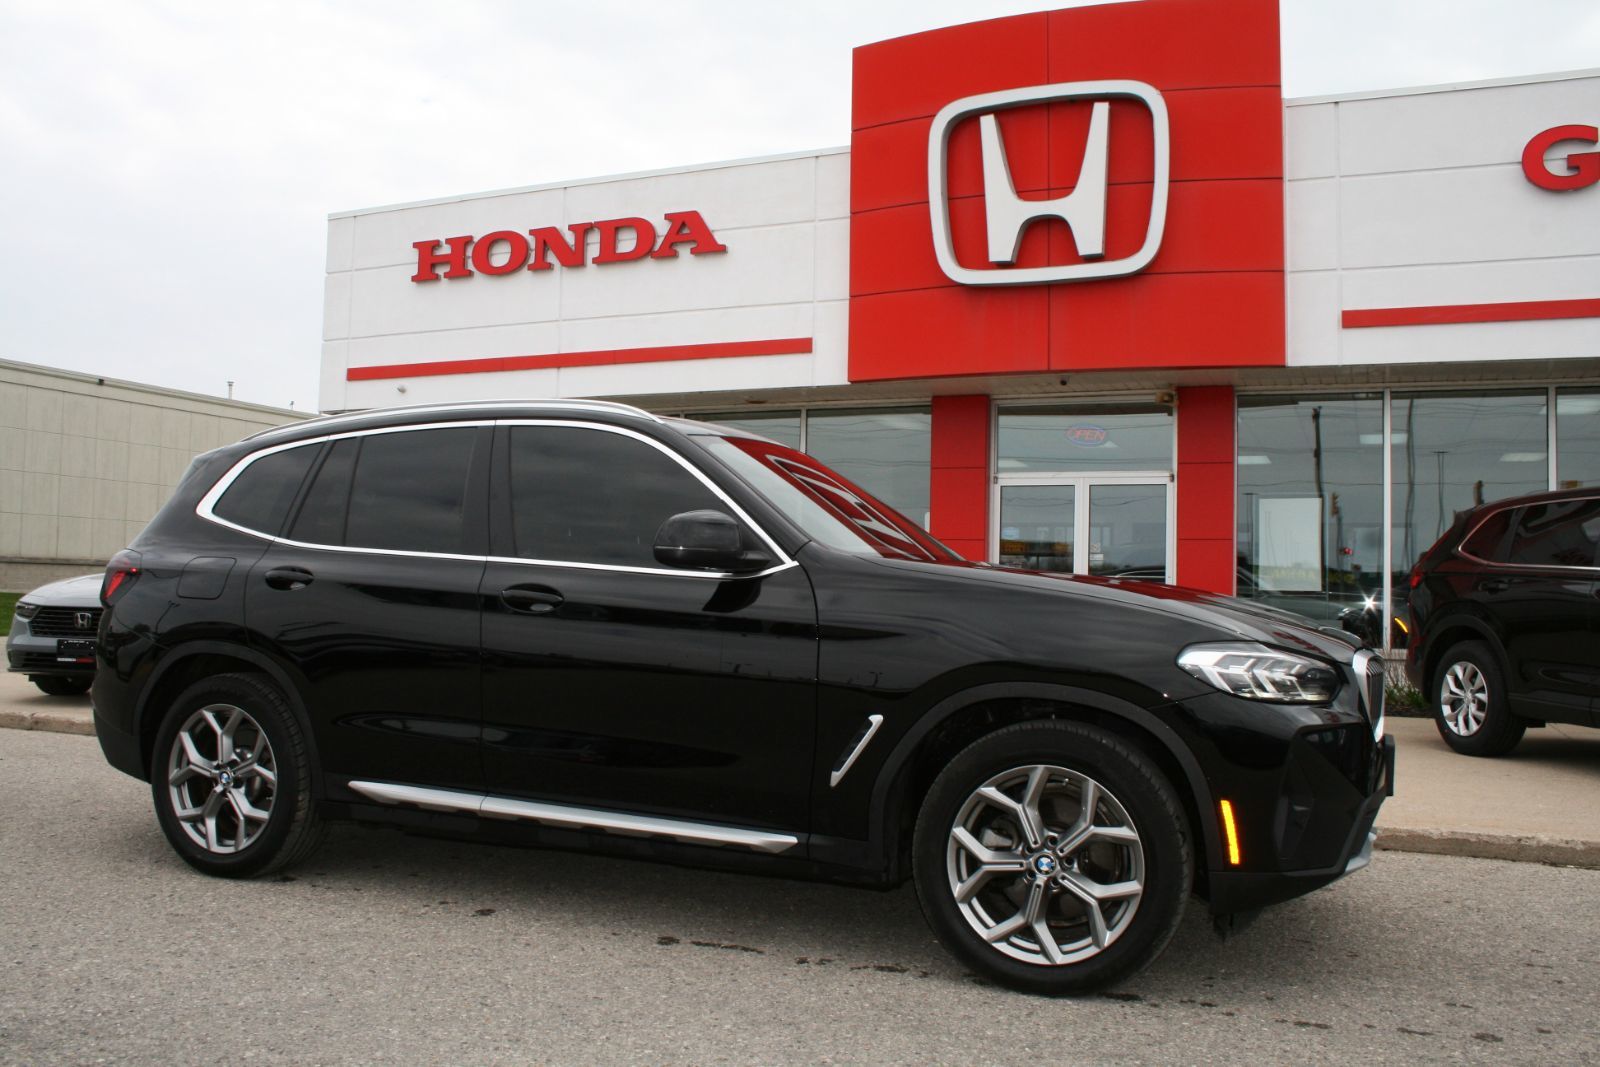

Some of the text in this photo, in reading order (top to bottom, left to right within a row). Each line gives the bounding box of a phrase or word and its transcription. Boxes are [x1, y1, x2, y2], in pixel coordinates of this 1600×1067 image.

[1521, 124, 1600, 191] G
[411, 210, 727, 282] HONDA
[1067, 428, 1106, 442] OPEN
